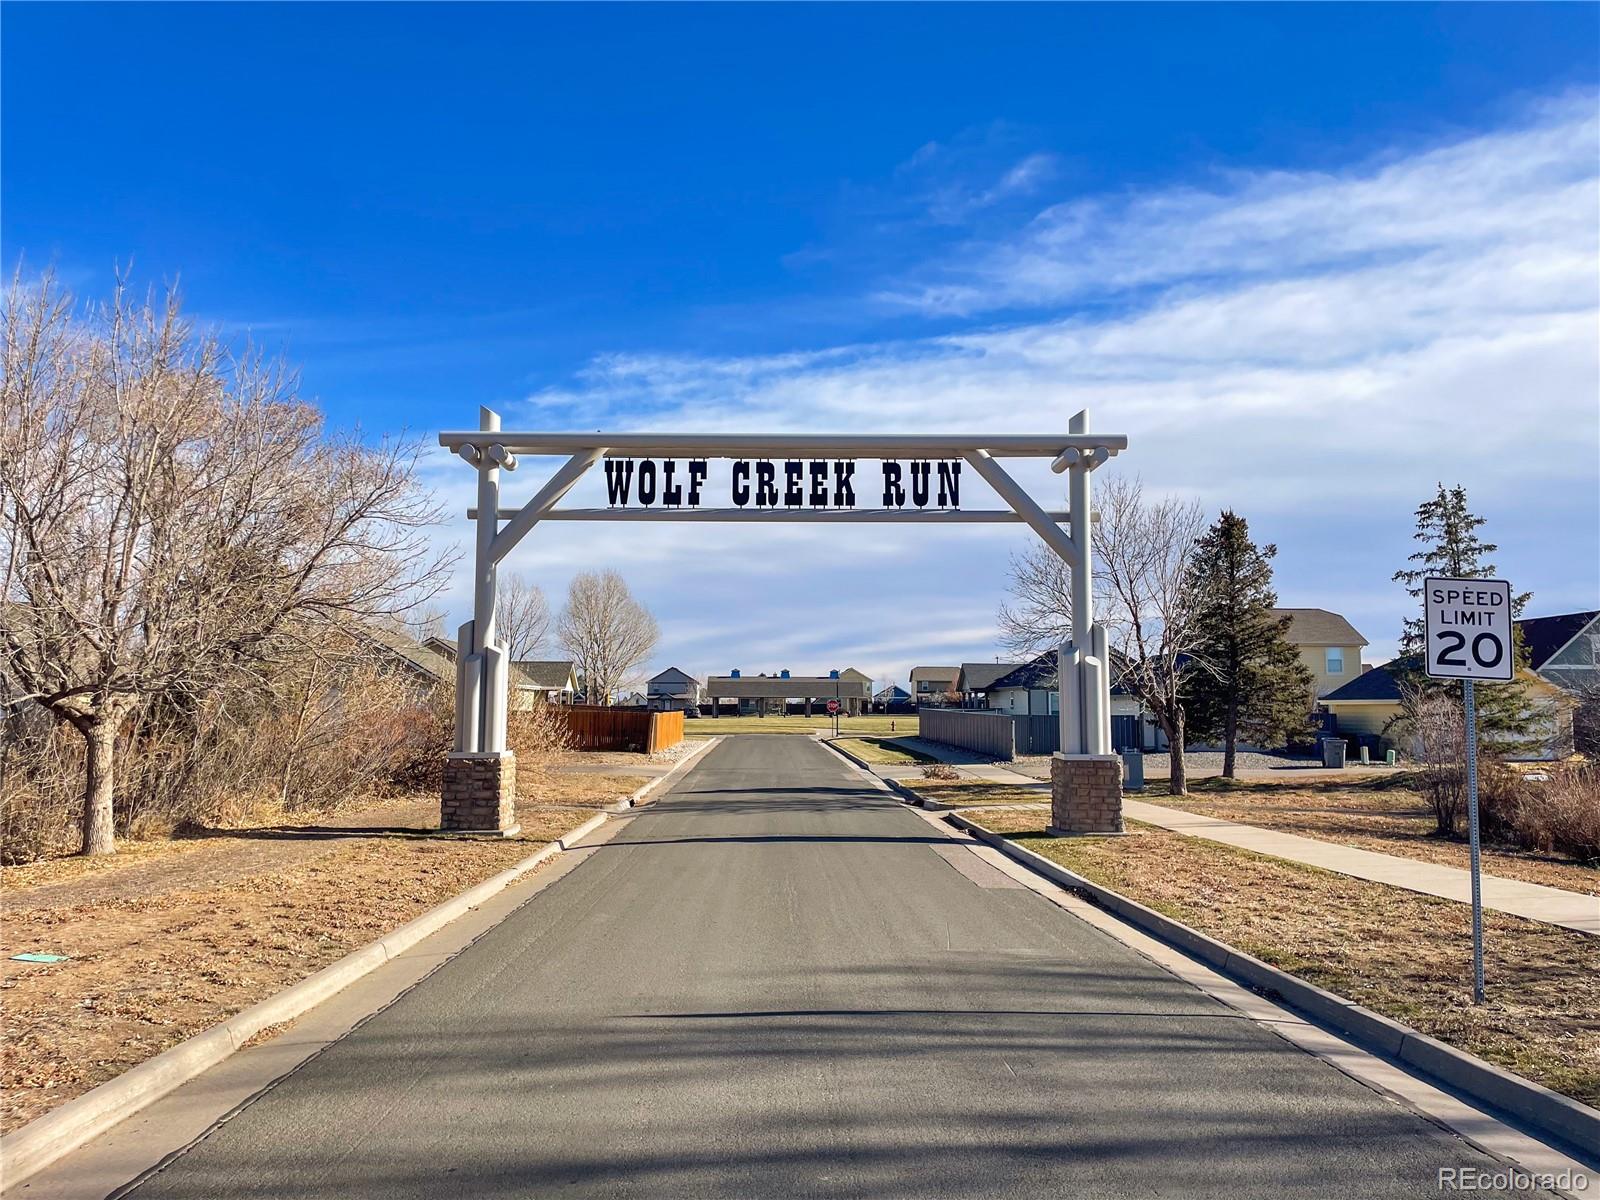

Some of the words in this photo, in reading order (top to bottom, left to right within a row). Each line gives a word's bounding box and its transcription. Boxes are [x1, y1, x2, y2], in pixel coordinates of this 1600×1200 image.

[604, 460, 707, 507] WOLF
[732, 460, 856, 507] CREEK
[882, 461, 961, 507] RUN
[1433, 589, 1503, 606] SPEED
[1441, 610, 1495, 626] LIMIT
[1436, 630, 1503, 668] 20
